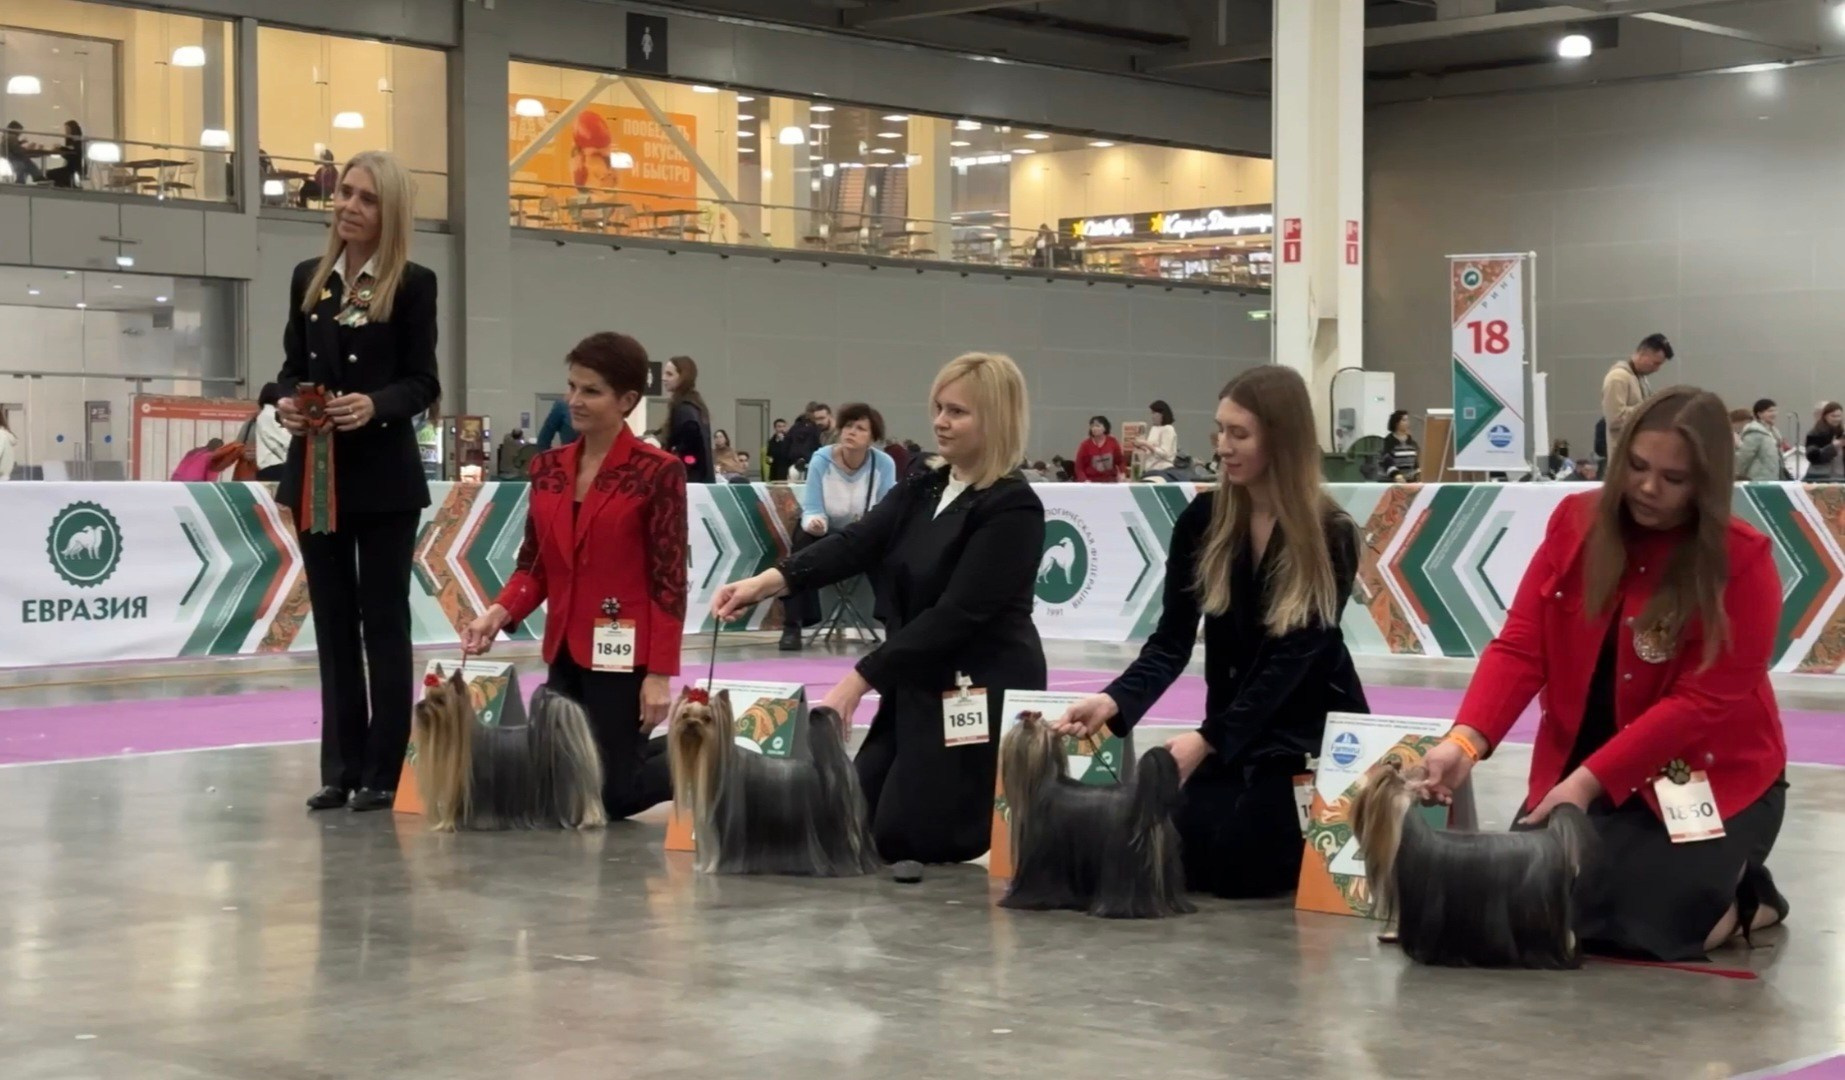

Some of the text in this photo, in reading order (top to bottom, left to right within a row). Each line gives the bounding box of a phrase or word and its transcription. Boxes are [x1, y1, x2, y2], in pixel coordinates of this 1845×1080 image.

[643, 162, 690, 182] БЫСТРО
[1467, 320, 1510, 354] 18
[22, 596, 148, 623] ЕВРАЗИЯ
[597, 642, 632, 656] 1849
[949, 711, 983, 728] 1851
